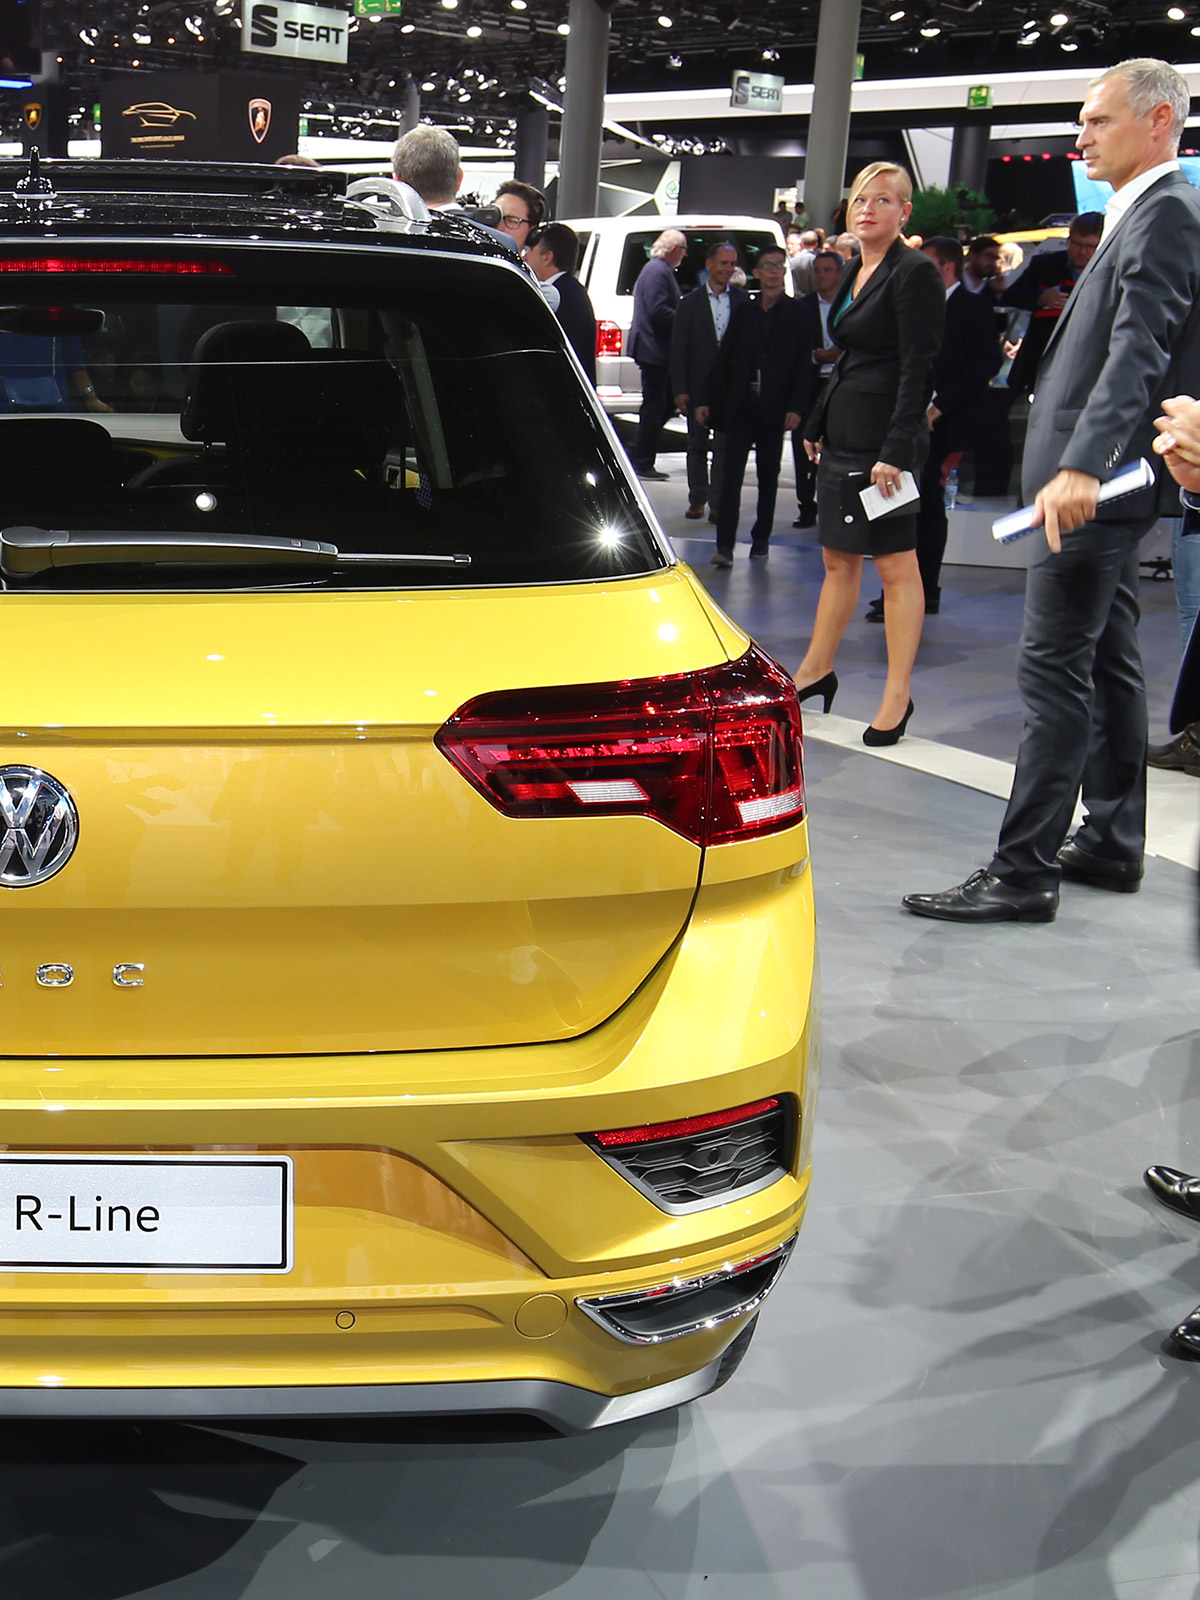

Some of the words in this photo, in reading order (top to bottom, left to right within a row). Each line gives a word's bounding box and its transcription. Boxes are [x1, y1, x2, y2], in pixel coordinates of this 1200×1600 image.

[284, 21, 345, 44] SEAT
[751, 85, 780, 101] SEAT
[15, 1195, 160, 1232] R-Line
